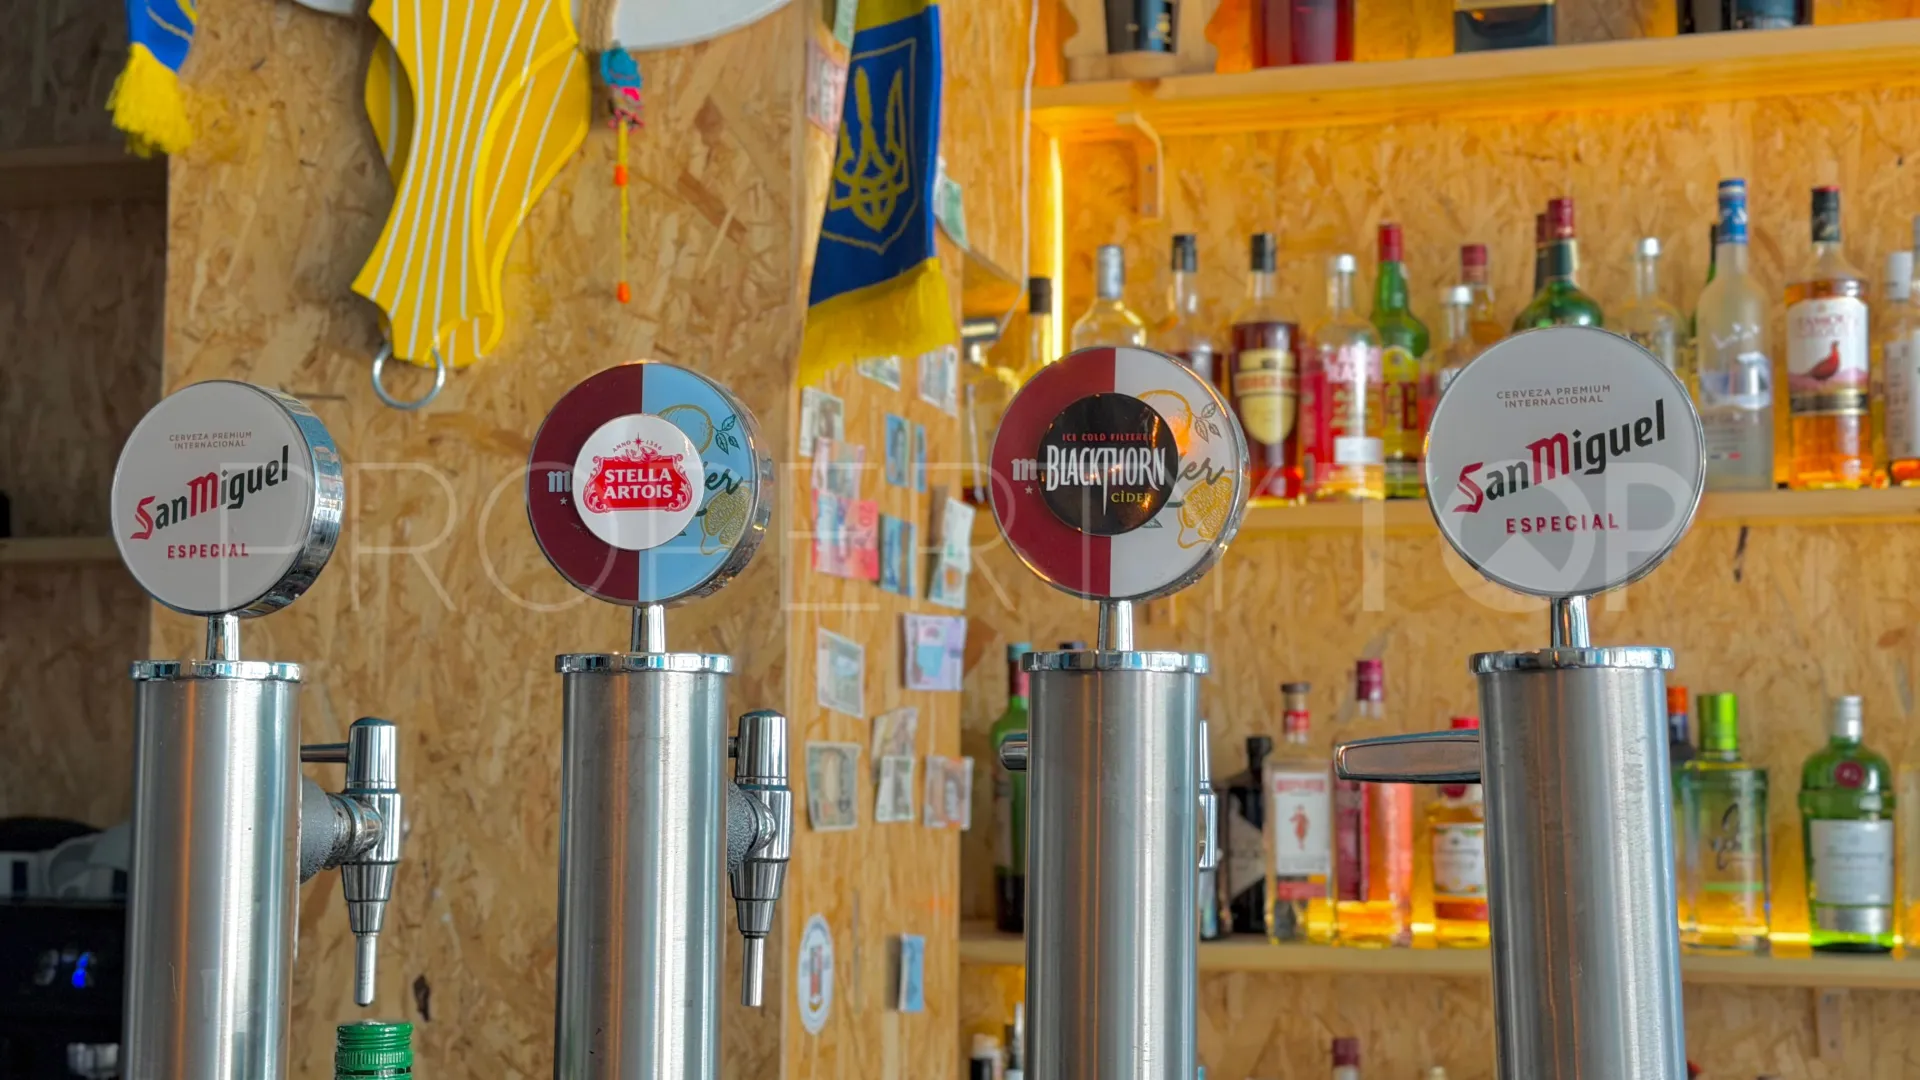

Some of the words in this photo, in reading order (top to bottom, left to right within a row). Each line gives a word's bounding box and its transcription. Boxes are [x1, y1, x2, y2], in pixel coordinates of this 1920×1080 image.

[1496, 387, 1551, 400] CERVEZA
[1556, 384, 1611, 396] PREMIUM
[1505, 394, 1603, 408] INTERNACIONAL
[169, 431, 209, 442] CERVEZA
[212, 431, 252, 440] PREMIUM
[1062, 433, 1077, 442] ICE
[1081, 433, 1107, 442] COLD
[174, 441, 246, 450] INTERNACIONAL
[612, 440, 631, 453] ANNO
[604, 467, 673, 483] STELLA
[1046, 445, 1166, 516] BLACKTHORN
[603, 484, 673, 500] ARTOIS
[1506, 512, 1620, 535] ESPECIAL
[167, 542, 250, 560] ESPECIAL
